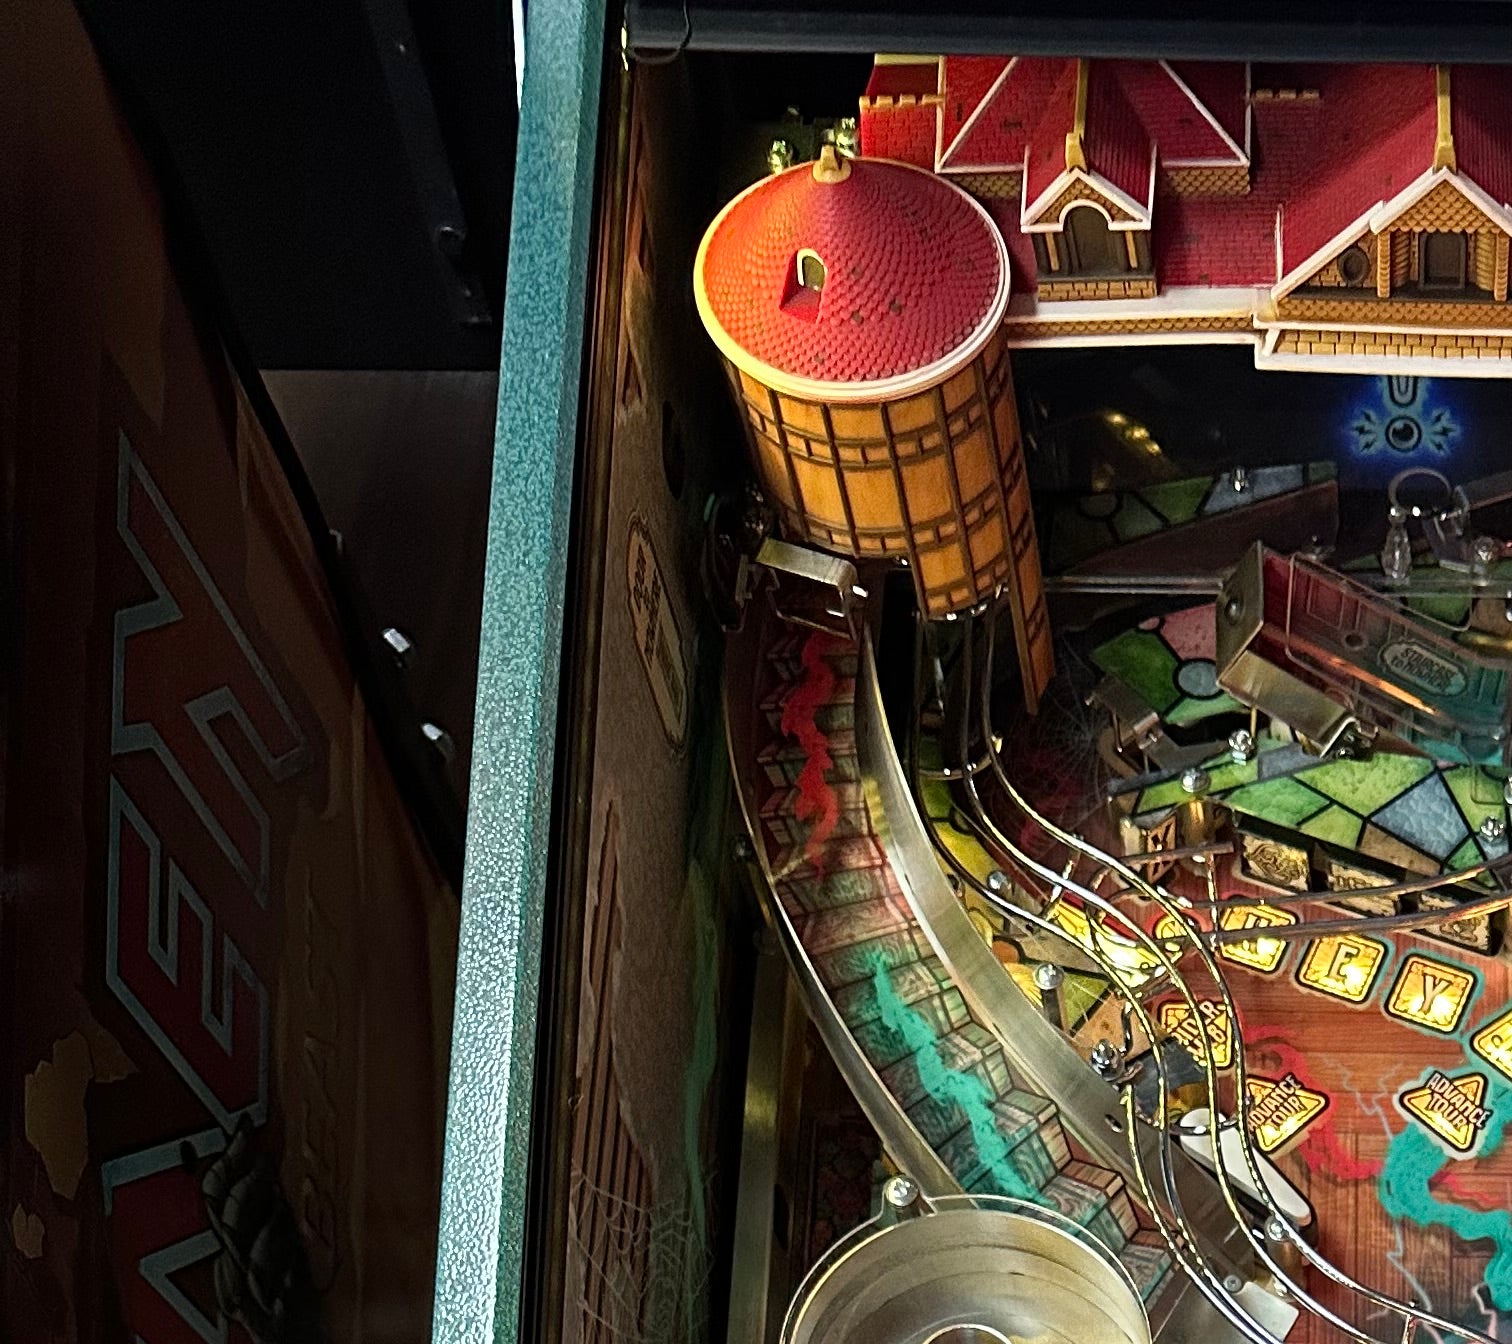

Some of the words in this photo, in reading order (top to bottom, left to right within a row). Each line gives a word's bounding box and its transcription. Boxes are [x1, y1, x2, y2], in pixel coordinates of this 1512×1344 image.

[1421, 973, 1451, 1015] Y
[1247, 1077, 1302, 1131] ADVANCE
[1266, 1096, 1306, 1132] TOUR
[1427, 1072, 1493, 1129] ADVANCE
[1429, 1092, 1468, 1129] TOUR
